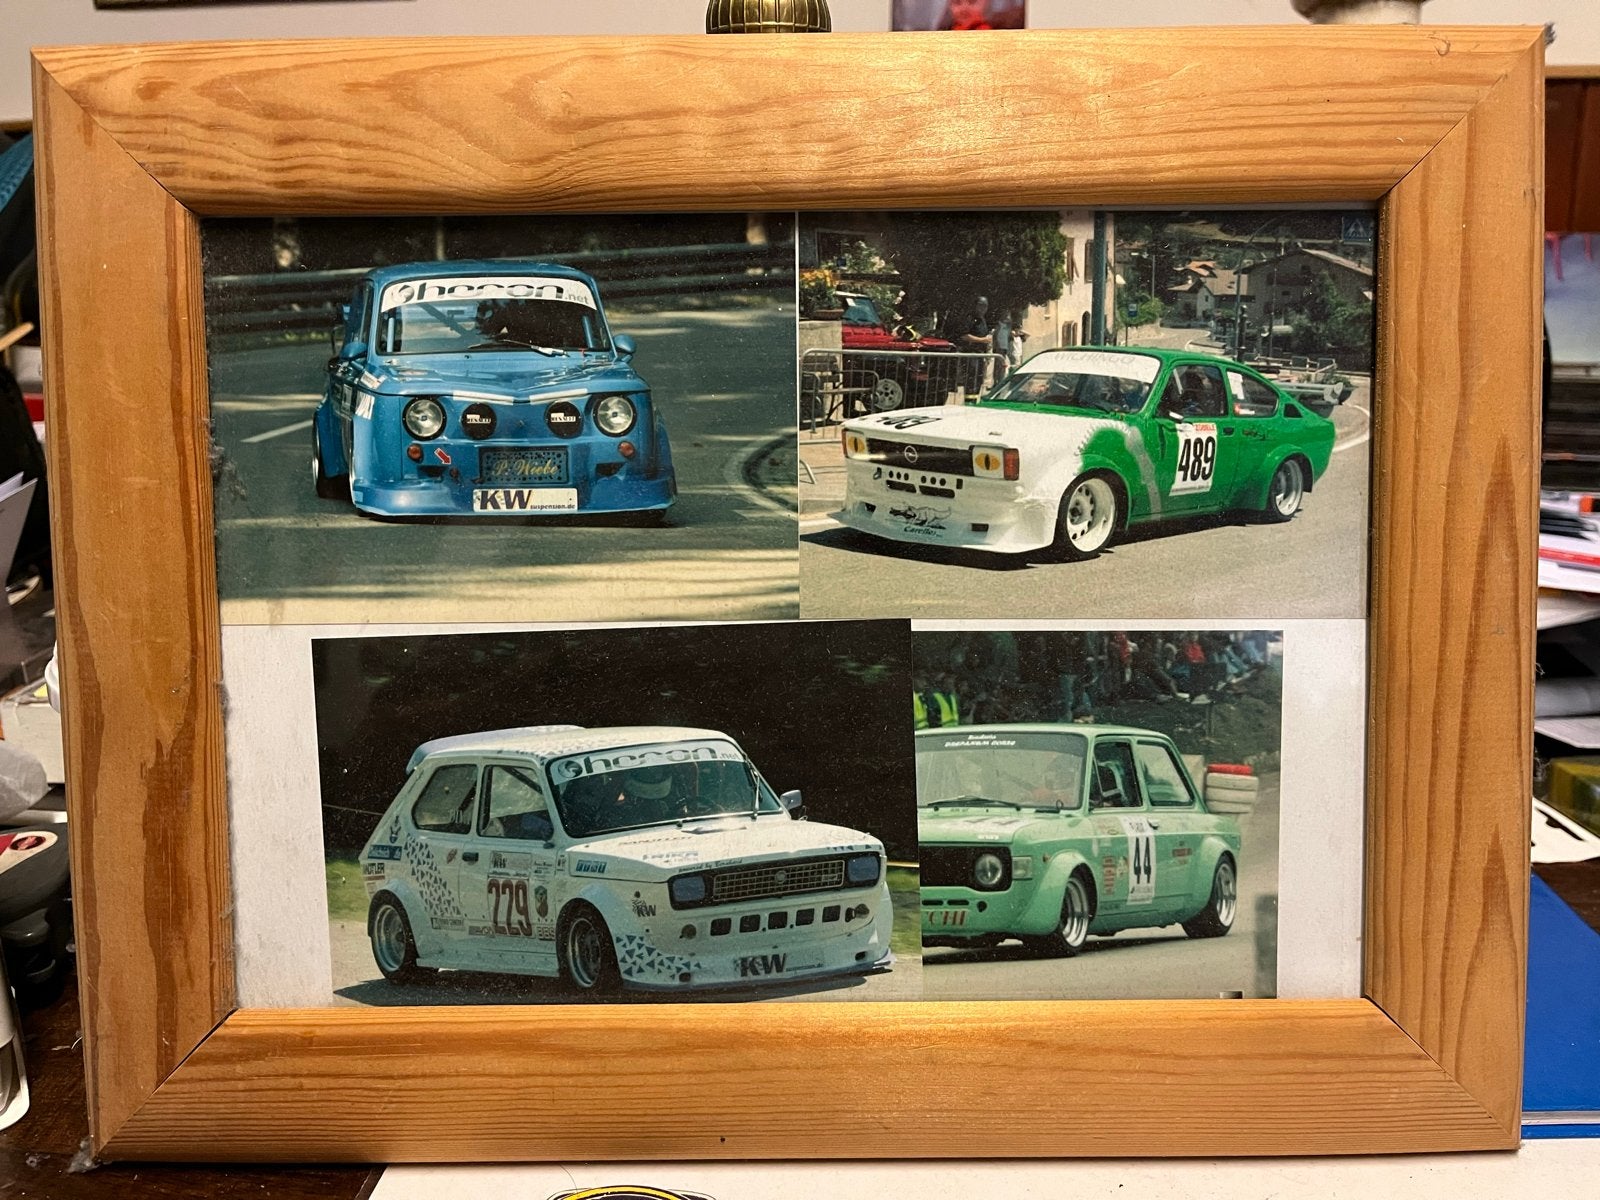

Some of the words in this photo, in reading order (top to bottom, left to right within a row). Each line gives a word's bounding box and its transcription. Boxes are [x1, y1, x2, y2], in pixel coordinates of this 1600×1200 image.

[1178, 436, 1216, 481] 489
[480, 489, 532, 510] KW
[530, 503, 576, 511] suspension.de
[1134, 836, 1152, 885] 44
[487, 878, 533, 937] 229
[740, 952, 787, 978] KW
